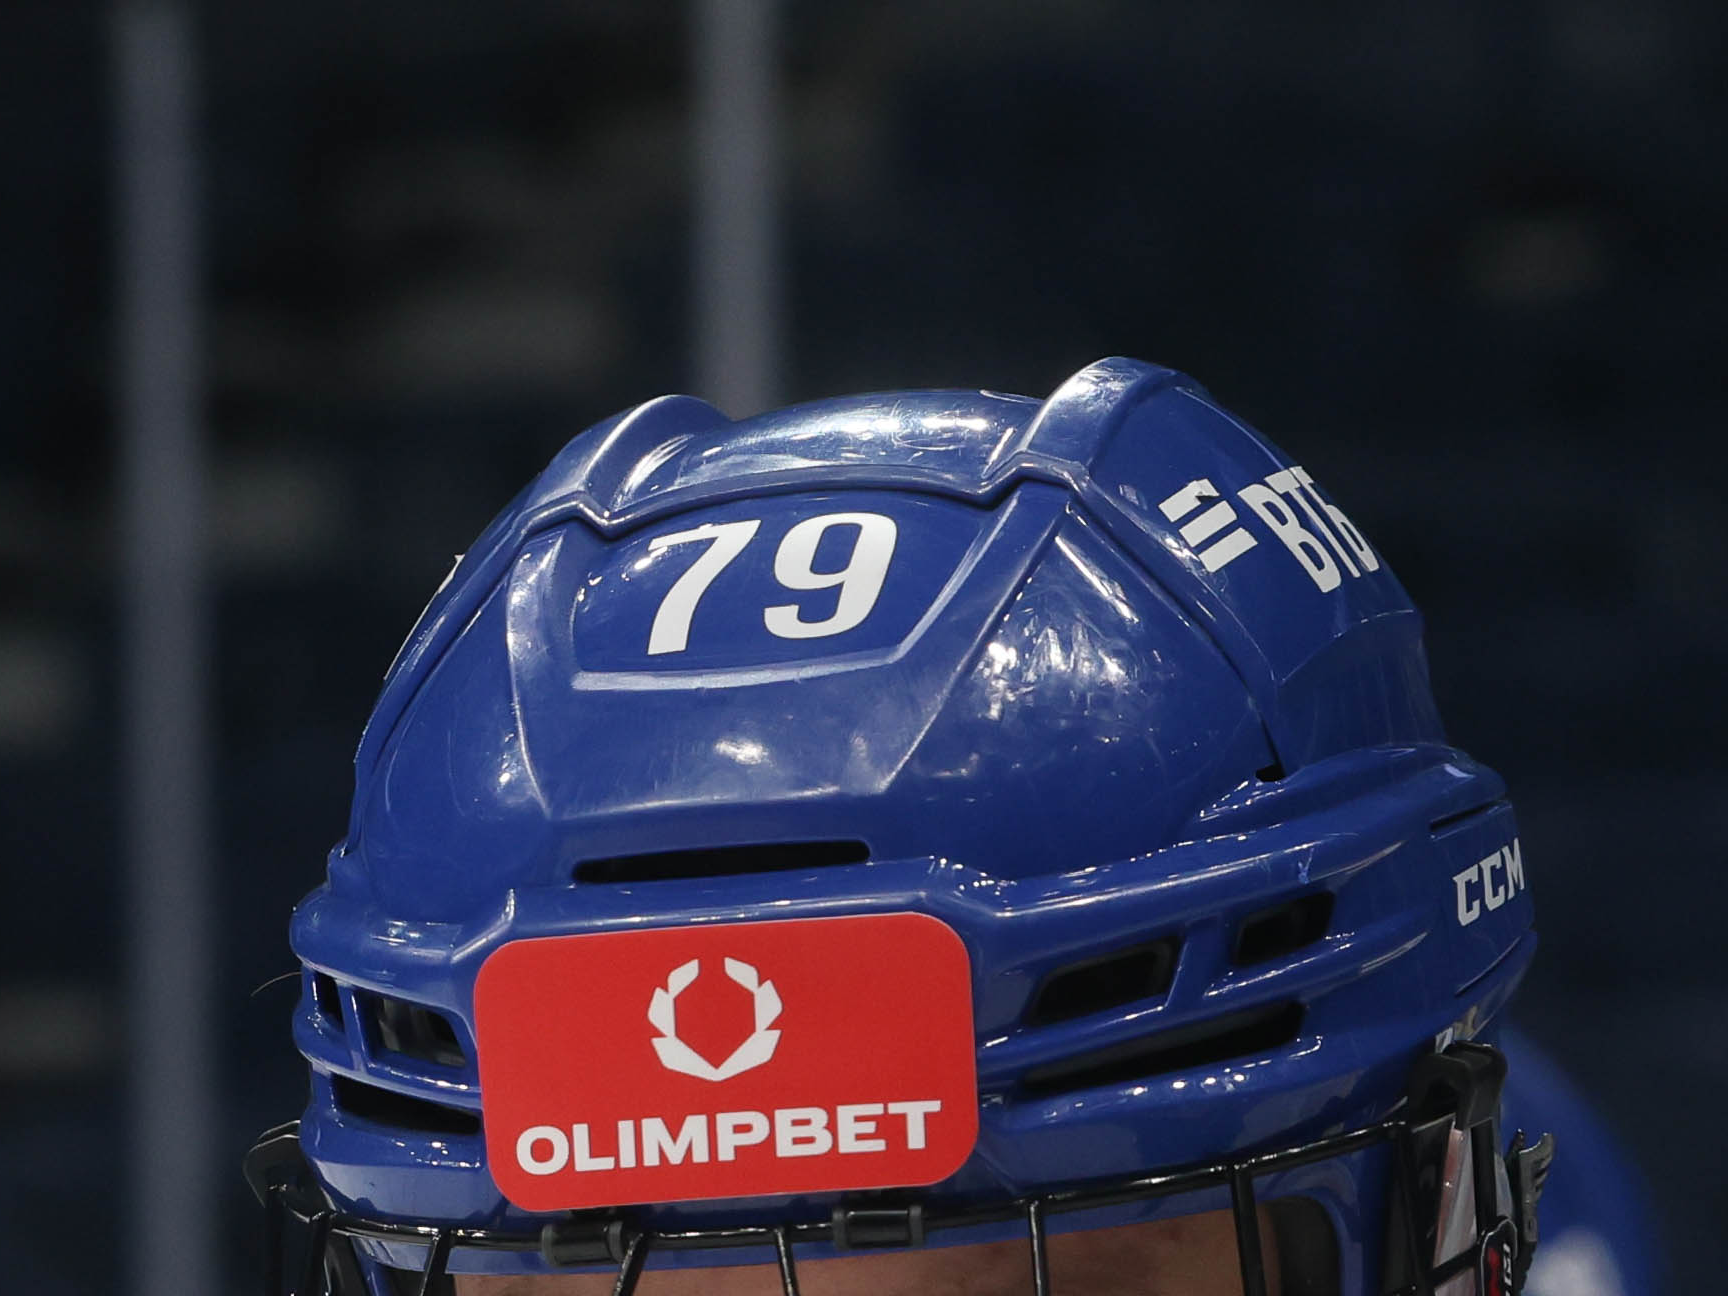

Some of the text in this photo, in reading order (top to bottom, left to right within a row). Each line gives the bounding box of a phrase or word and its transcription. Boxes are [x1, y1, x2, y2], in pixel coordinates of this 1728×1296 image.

[645, 512, 897, 654] 79
[1453, 837, 1524, 926] CCM
[516, 1099, 942, 1176] OLIMPBET
